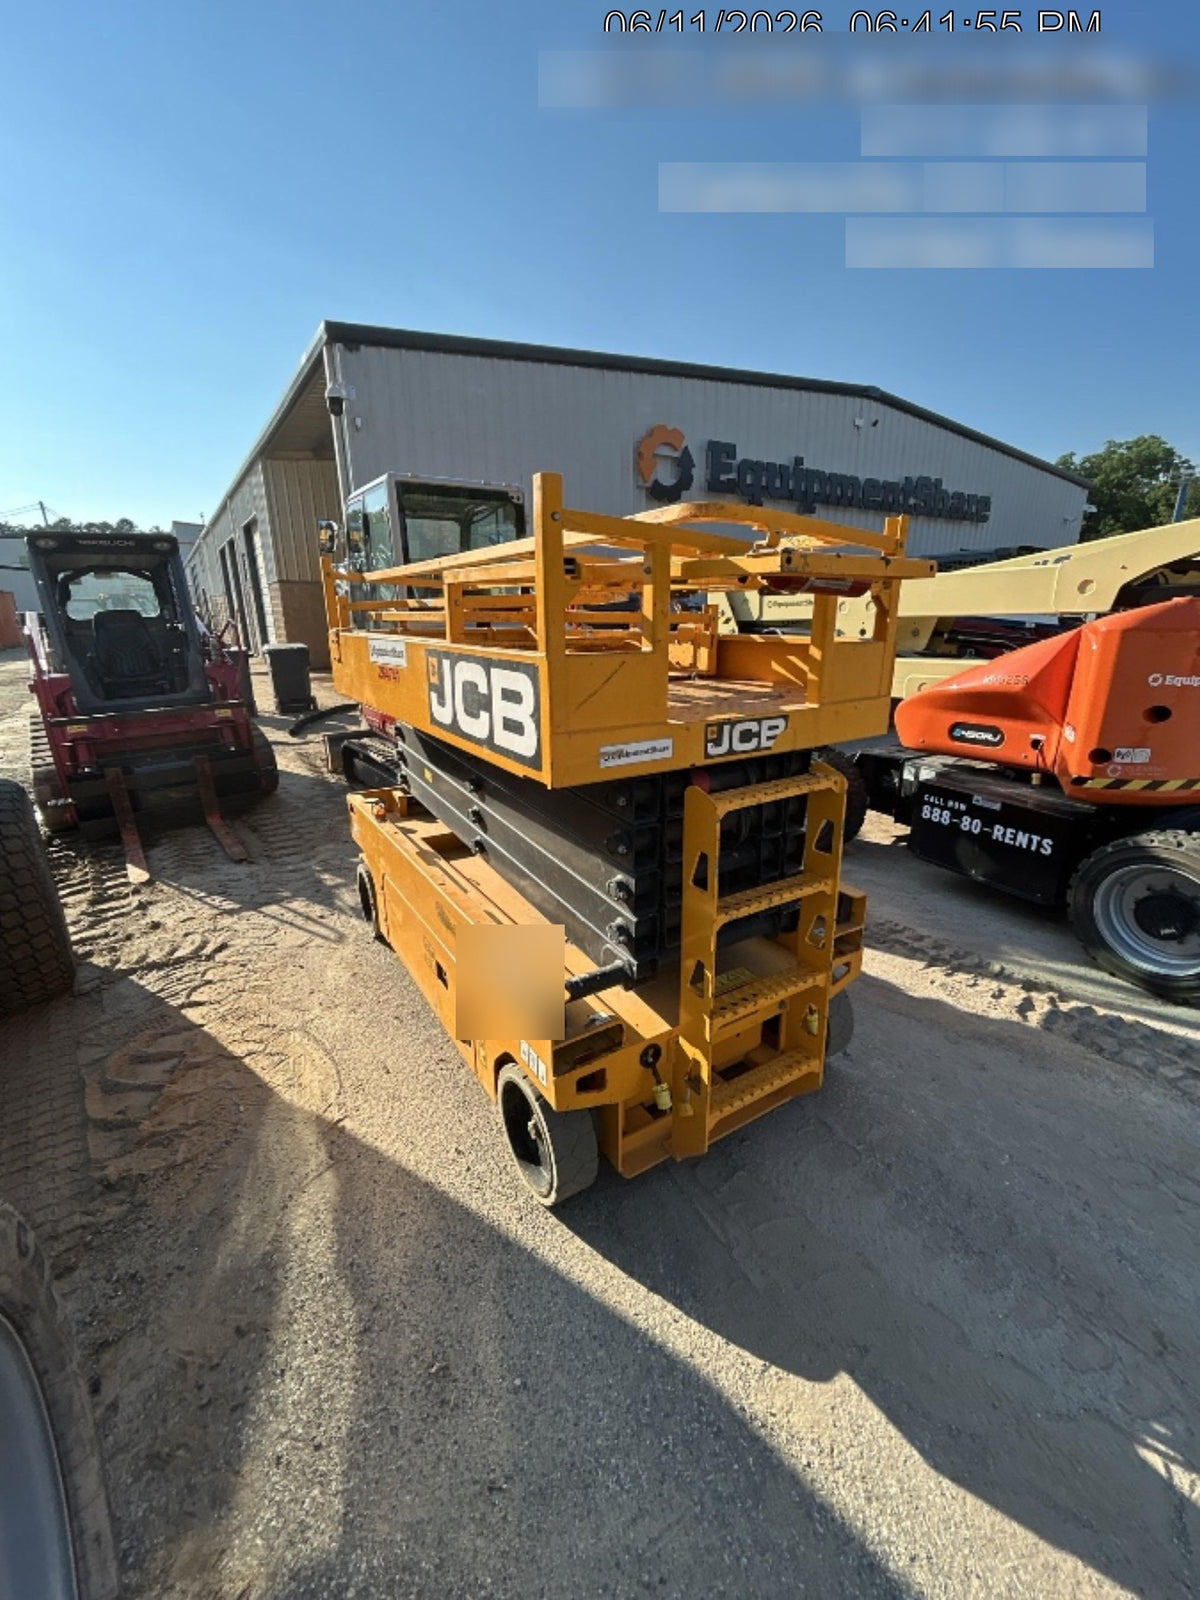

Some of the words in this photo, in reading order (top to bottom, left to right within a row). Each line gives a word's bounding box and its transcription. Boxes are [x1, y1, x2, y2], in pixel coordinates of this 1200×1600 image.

[706, 439, 992, 524] EquipmentShare
[430, 658, 539, 759] JCB
[921, 804, 1054, 856] 888-80-RENTS
